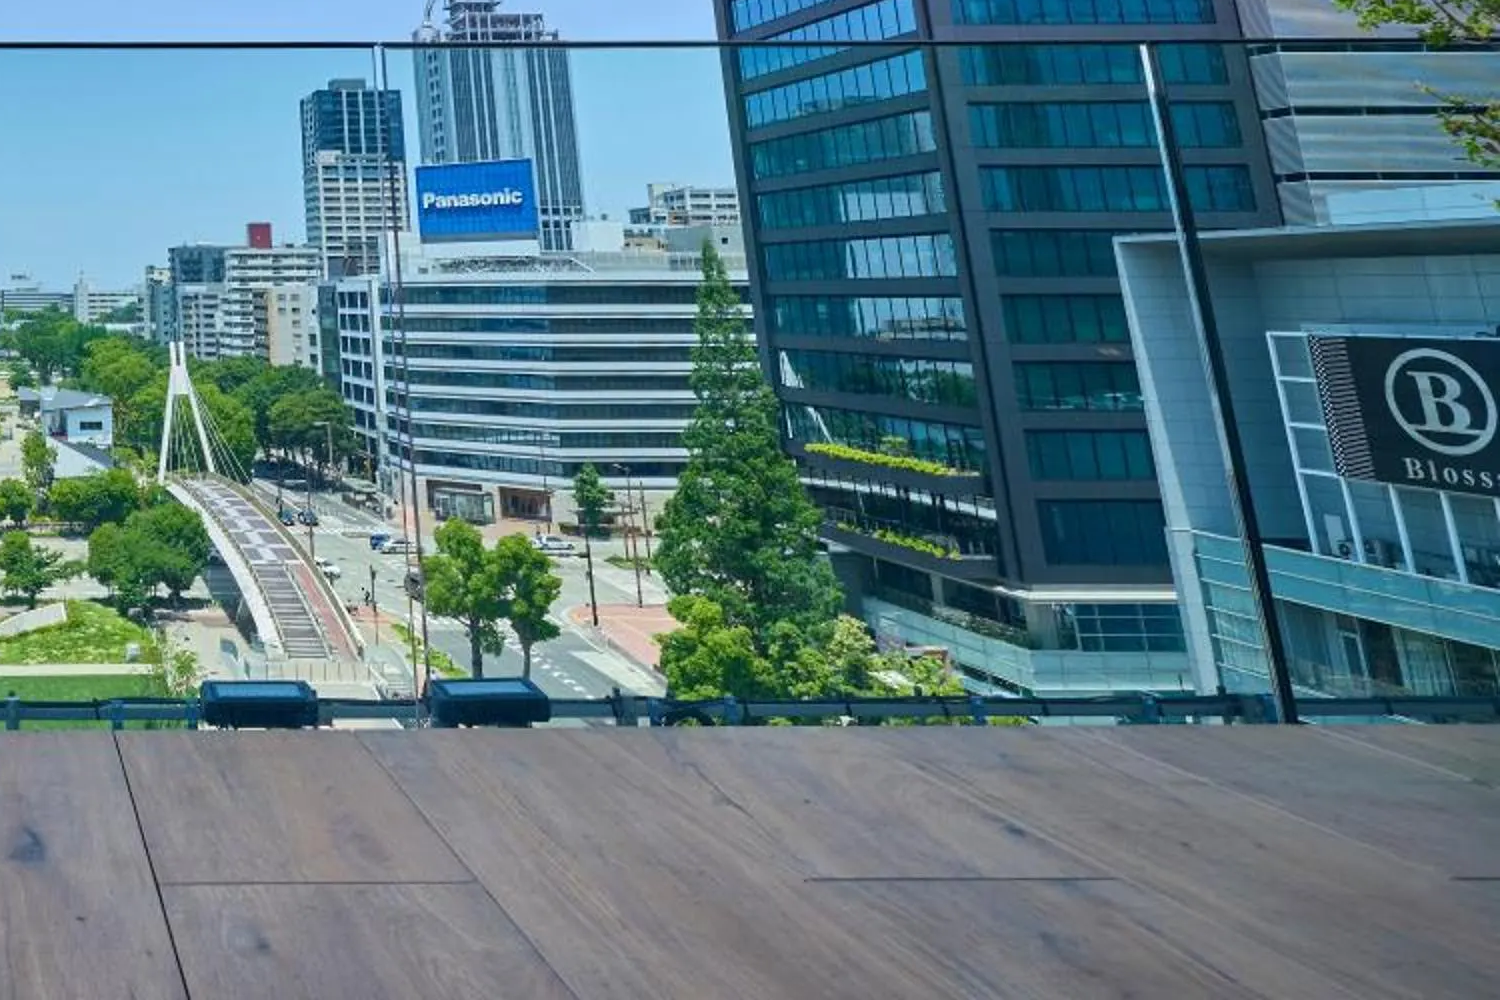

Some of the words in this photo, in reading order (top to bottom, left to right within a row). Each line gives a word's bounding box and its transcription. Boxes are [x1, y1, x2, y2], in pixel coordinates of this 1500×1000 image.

[422, 187, 523, 209] Panasonic
[1405, 371, 1472, 431] B
[1402, 457, 1500, 489] Bloss
